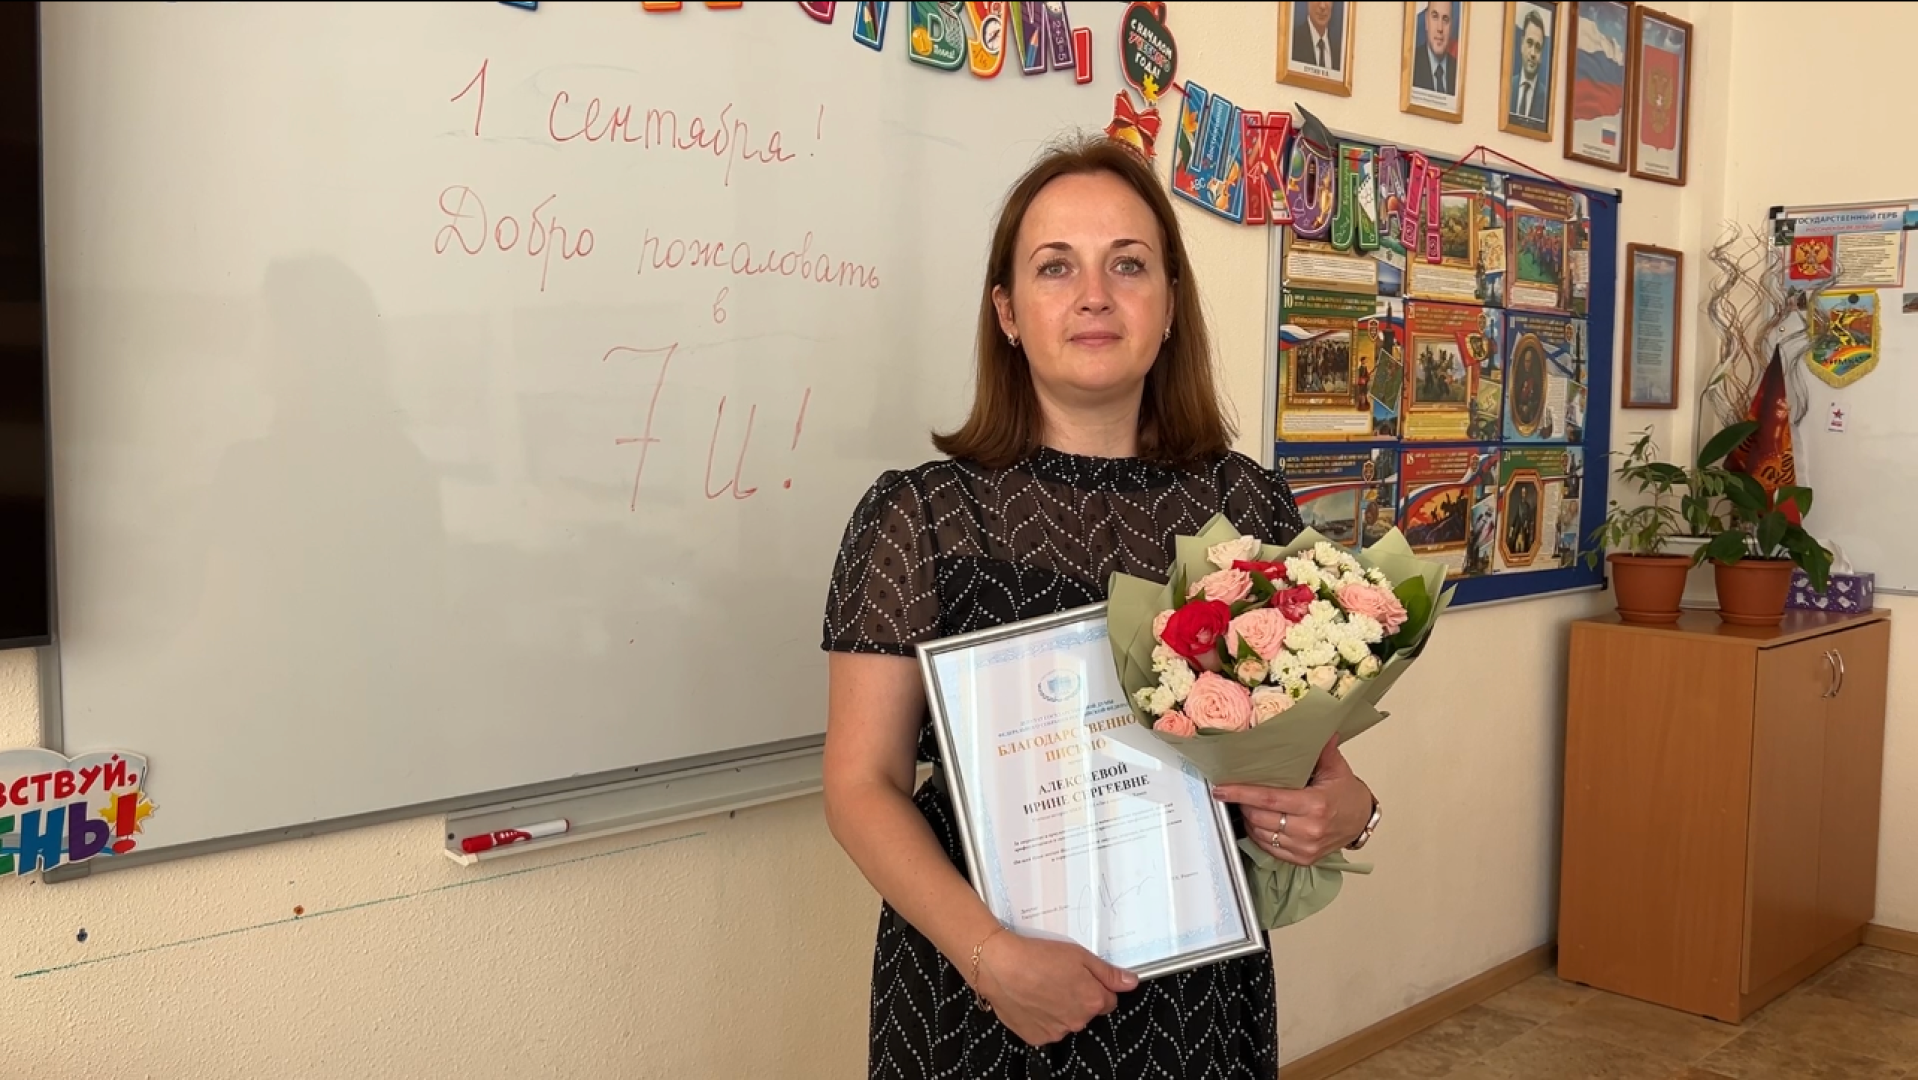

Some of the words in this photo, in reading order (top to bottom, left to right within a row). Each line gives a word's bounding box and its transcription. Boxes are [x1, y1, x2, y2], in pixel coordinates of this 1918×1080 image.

[1136, 21, 1172, 60] НАЧАЛОМ
[1134, 51, 1161, 79] ГОДА!
[449, 57, 489, 138] 1
[1877, 211, 1898, 220] ГЕРБ
[434, 183, 595, 293] Добро
[636, 226, 882, 291] пожаловать
[712, 286, 727, 325] в
[1283, 293, 1294, 309] 10
[601, 340, 680, 513] 7
[1278, 456, 1287, 472] 9
[1022, 793, 1070, 816] ИРИНЕ
